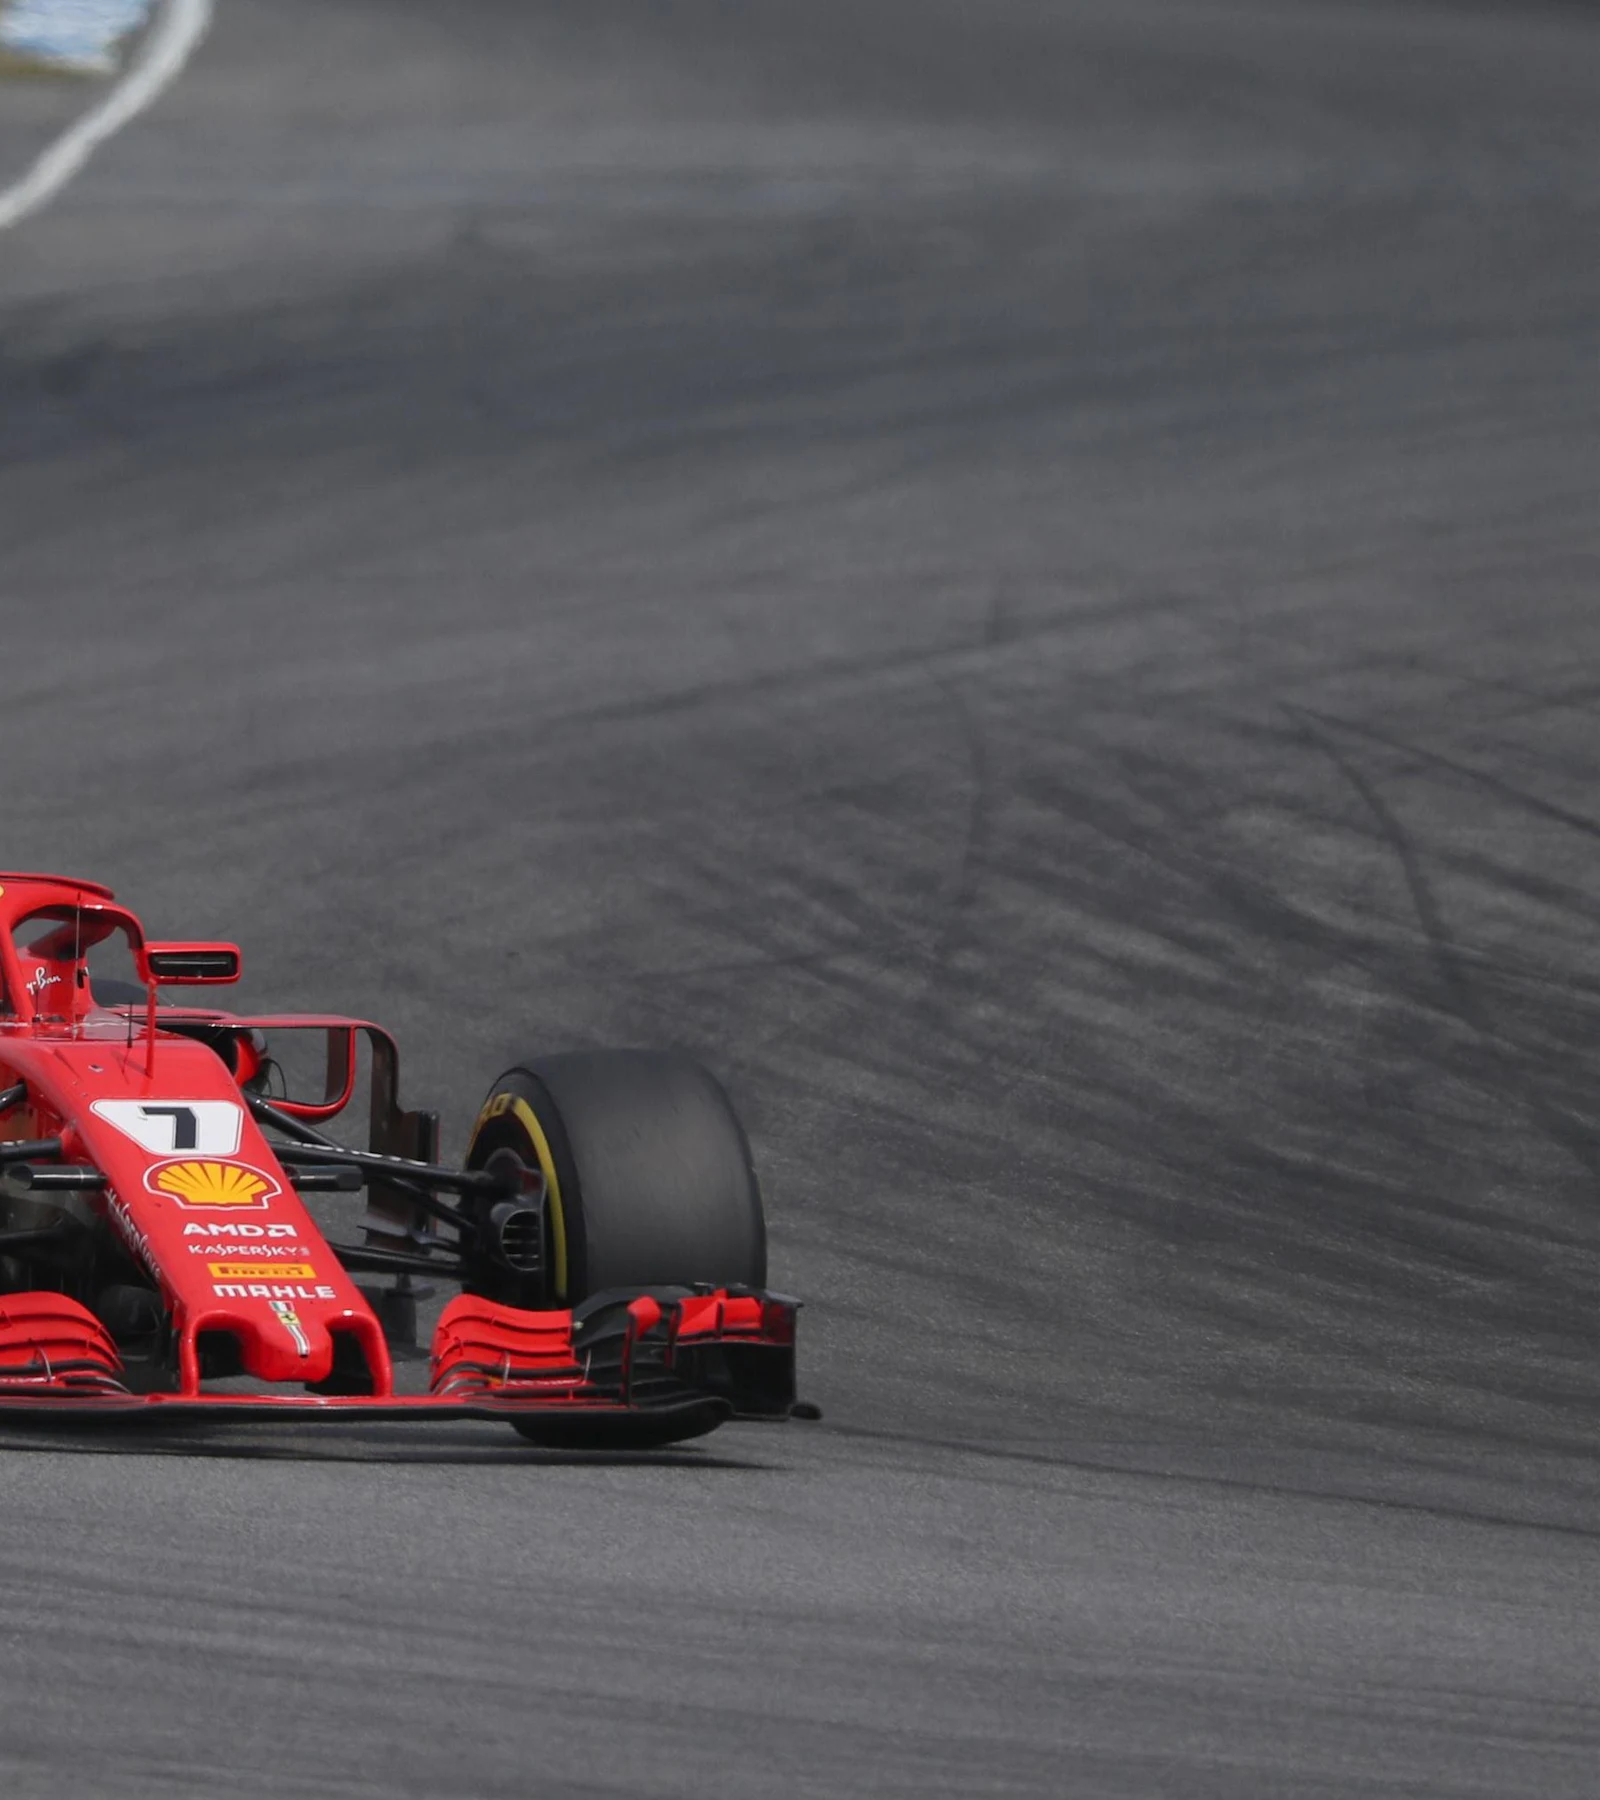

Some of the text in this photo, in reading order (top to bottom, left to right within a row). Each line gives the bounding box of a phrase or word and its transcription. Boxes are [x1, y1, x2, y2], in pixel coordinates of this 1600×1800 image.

[139, 1105, 197, 1150] 7
[188, 1244, 297, 1257] KASPERSKY
[212, 1284, 337, 1299] MAHLE
